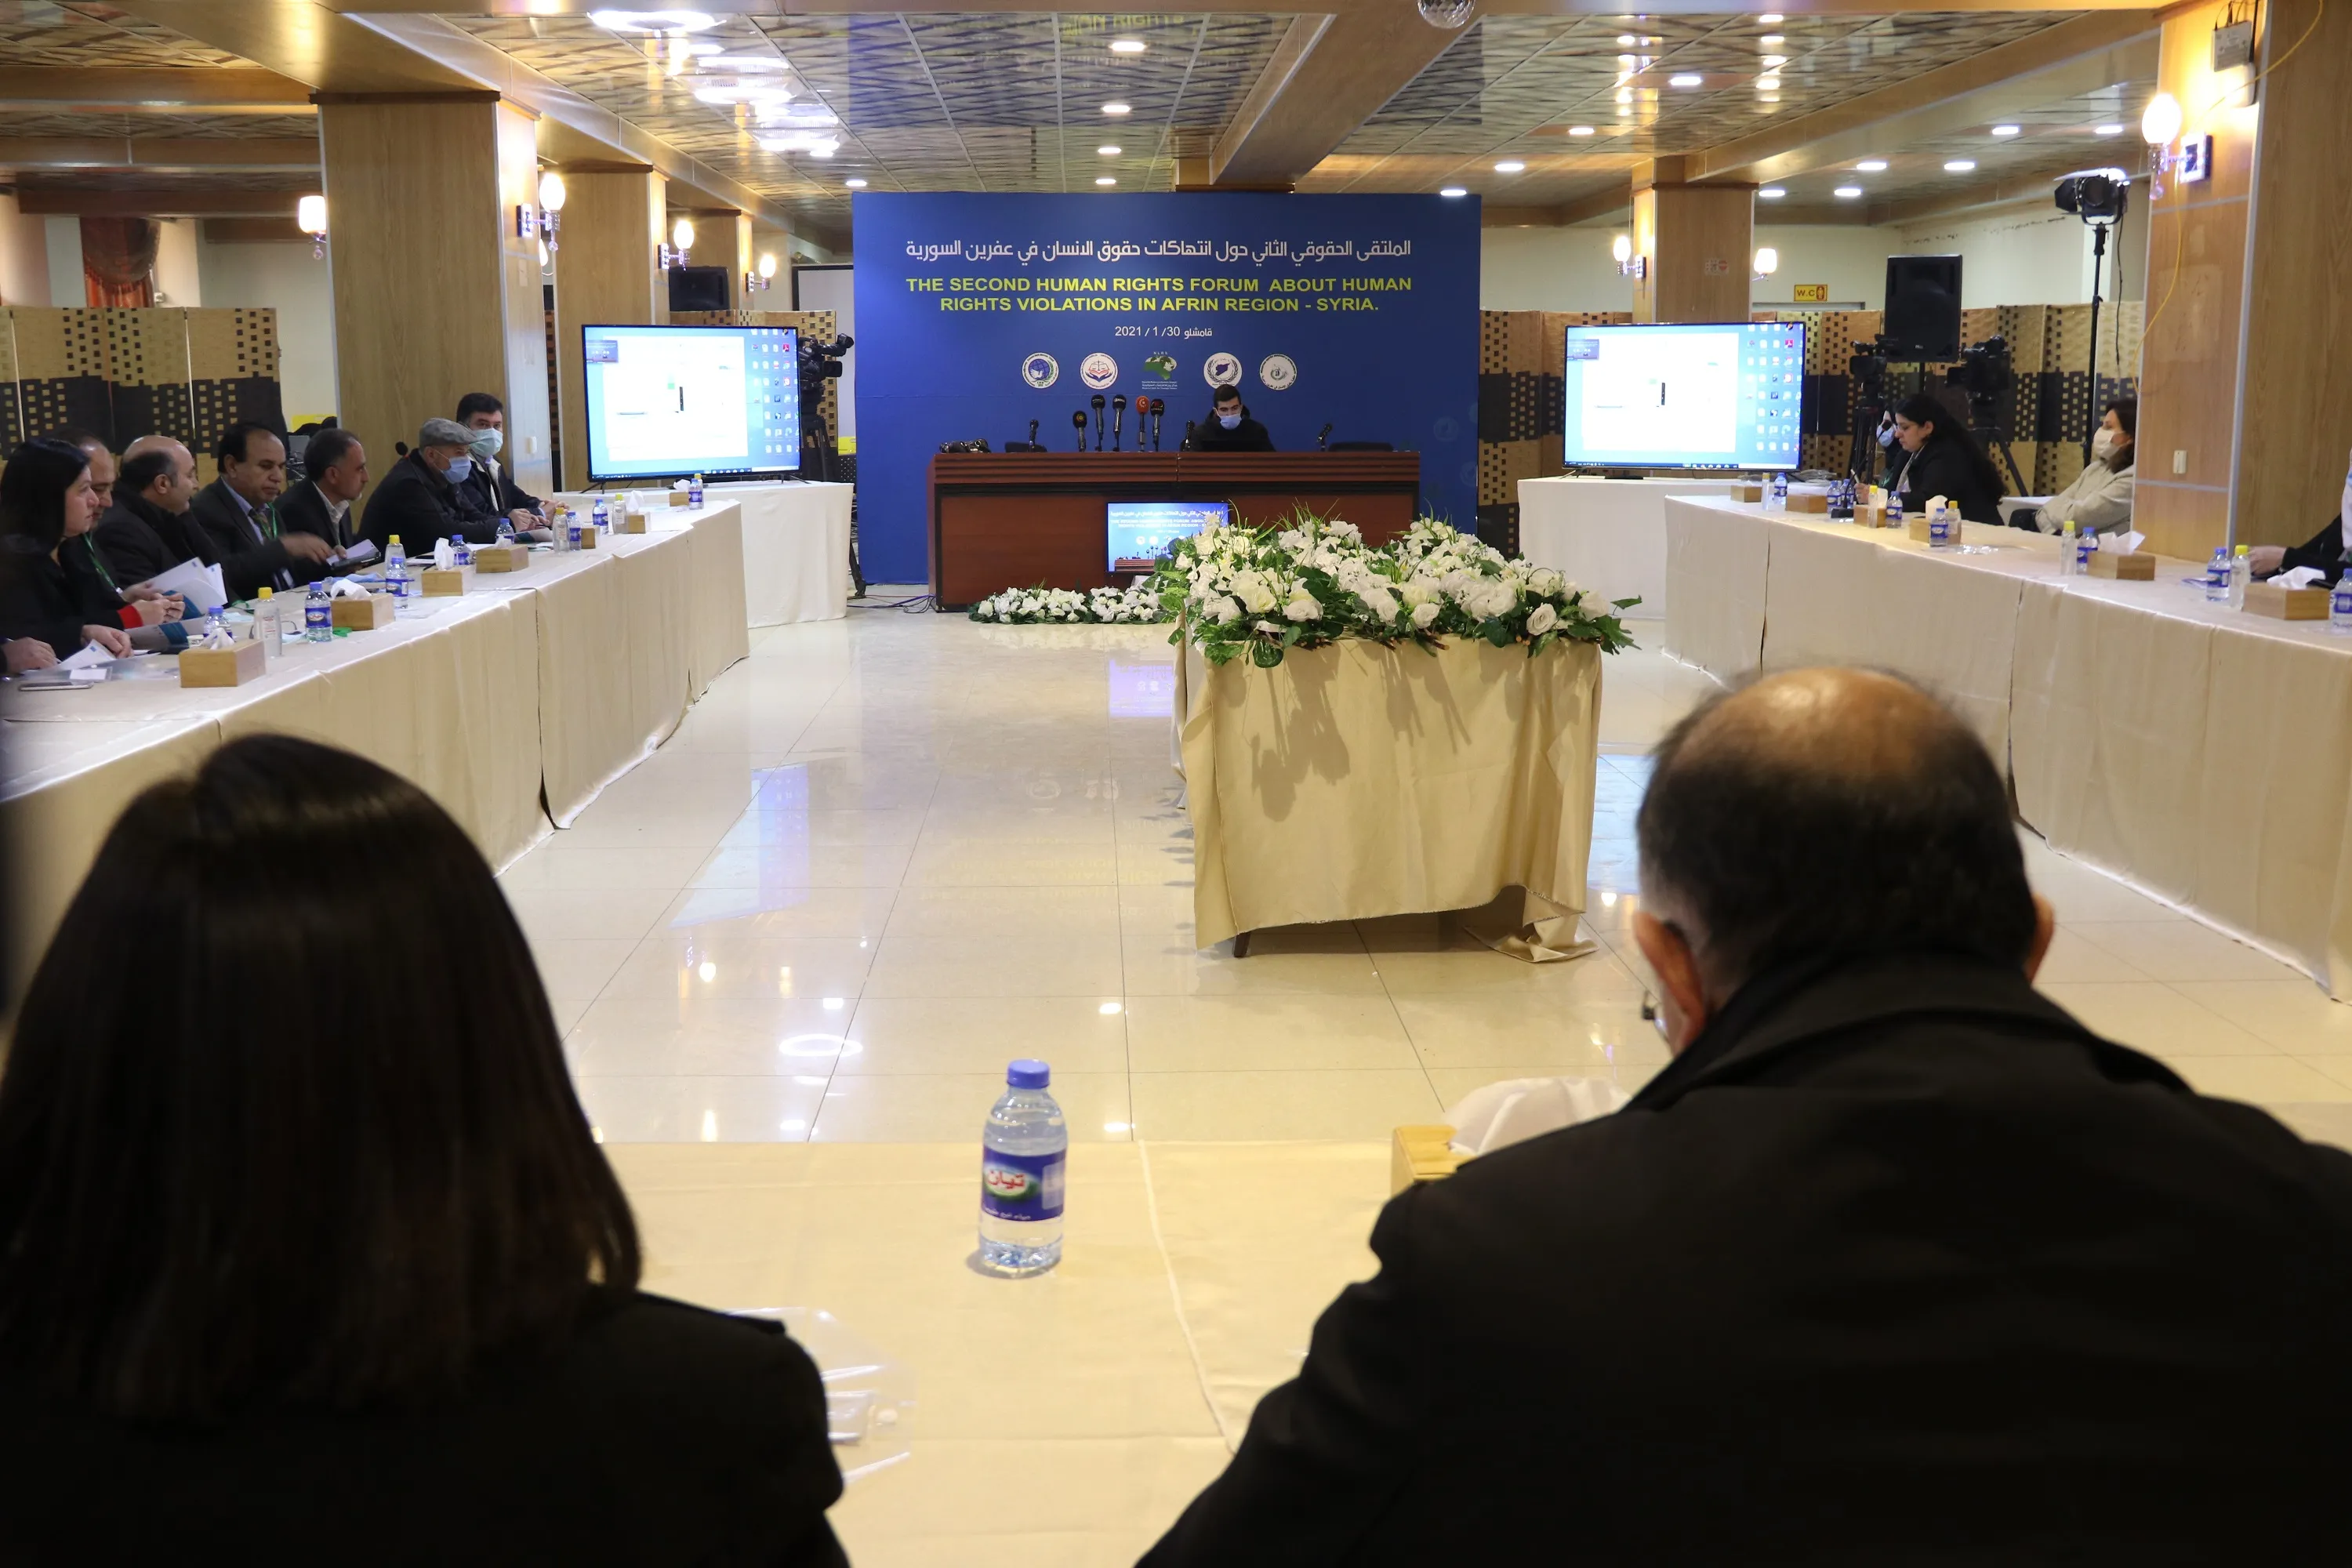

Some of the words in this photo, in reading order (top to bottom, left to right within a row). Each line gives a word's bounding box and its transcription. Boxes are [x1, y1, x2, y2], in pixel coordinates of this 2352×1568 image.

[906, 239, 961, 262] السورية
[965, 240, 1014, 262] عفرين
[1017, 240, 1038, 267] في
[1042, 240, 1094, 262] الانسان
[1097, 240, 1141, 263] حقوق
[1144, 240, 1211, 256] انتهاكات
[1215, 241, 1248, 262] حول
[1251, 239, 1287, 267] الثاني
[1291, 241, 1352, 267] الحقوقي
[1356, 240, 1410, 262] الملتقى
[906, 278, 944, 292] THE
[949, 278, 1031, 292] SECOND
[1036, 278, 1107, 292] HUMAN
[1112, 278, 1185, 292] RIGHTS
[1190, 278, 1258, 292] FORUM
[1269, 278, 1337, 292] ABOUT
[1342, 278, 1411, 291] HUMAN
[940, 297, 1011, 311] RIGHTS
[1016, 297, 1133, 311] VIOLATIONS
[1138, 297, 1156, 311] IN
[1160, 297, 1218, 311] AFRIN
[1225, 298, 1298, 311] REGION
[1316, 298, 1378, 311] SYRIA.
[1115, 325, 1142, 336] 2021
[1184, 327, 1213, 339] قامشلو
